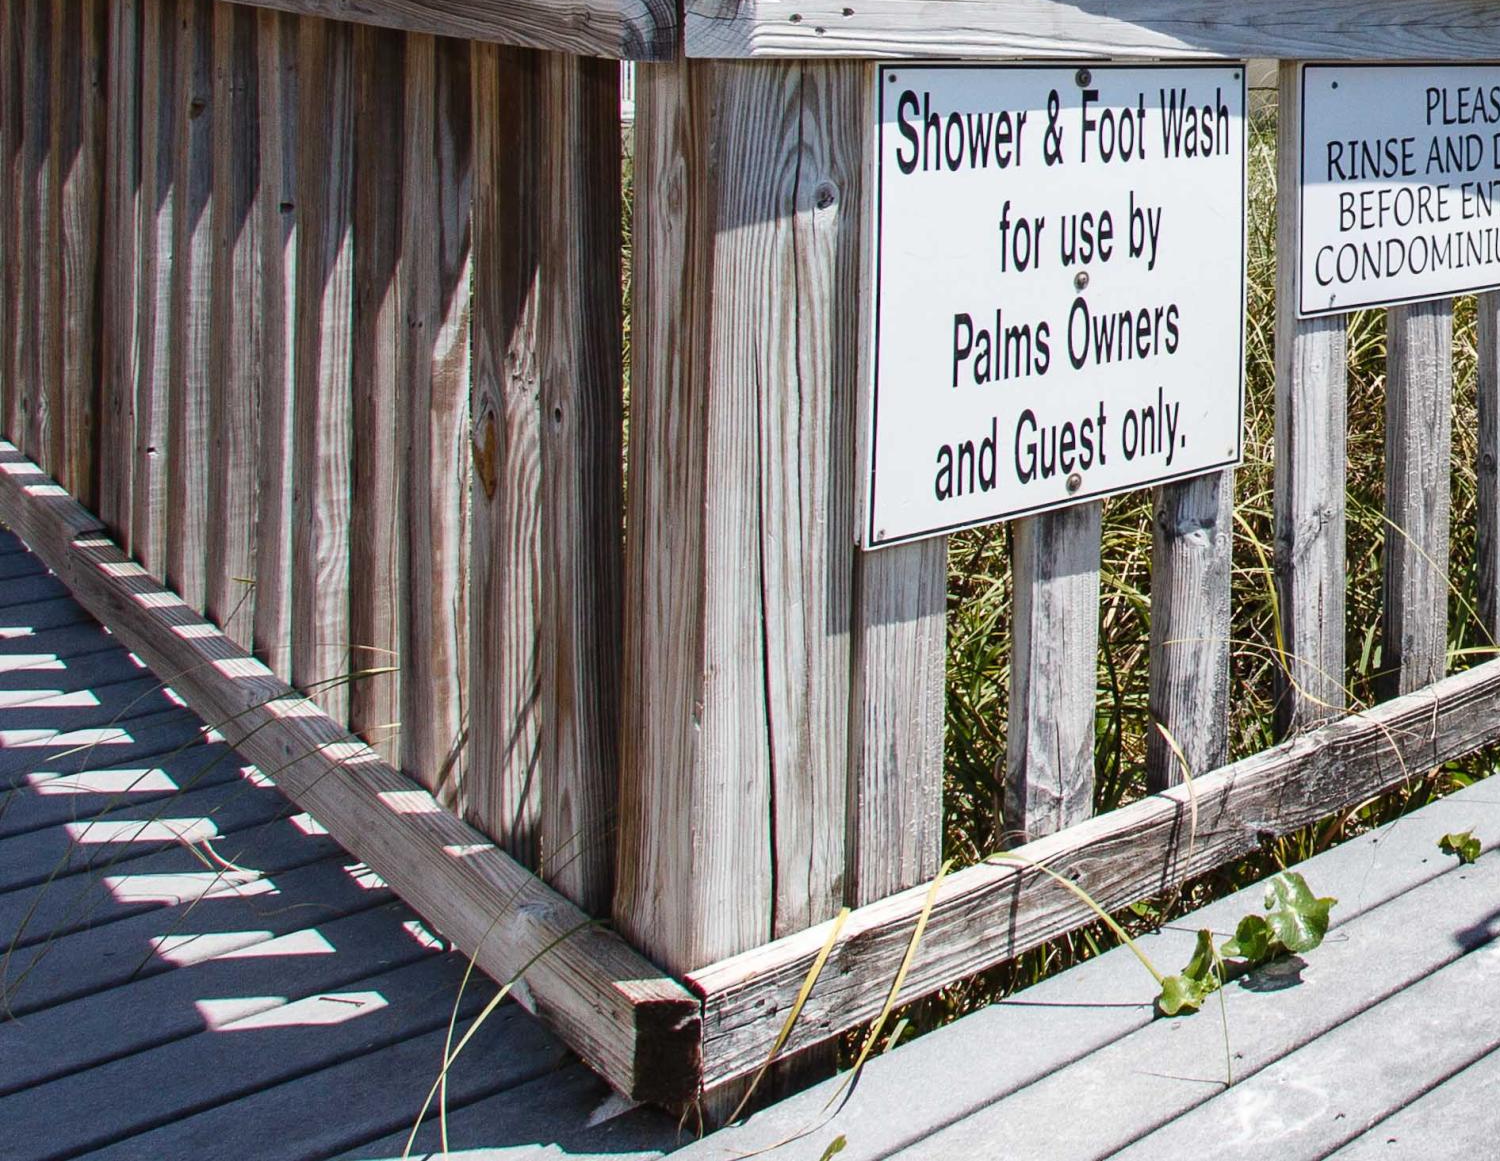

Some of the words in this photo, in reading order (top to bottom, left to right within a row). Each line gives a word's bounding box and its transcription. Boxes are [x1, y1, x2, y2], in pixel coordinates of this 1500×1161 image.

[896, 89, 1027, 175] Shower
[1044, 89, 1063, 166] &
[1081, 89, 1146, 163] Foot
[1160, 87, 1230, 159] Wash
[1327, 137, 1417, 181] RINSE
[1426, 133, 1483, 174] AND
[999, 200, 1044, 272] for
[1061, 209, 1113, 267] use
[1130, 191, 1162, 271] by
[1339, 184, 1450, 232] BEFORE
[953, 308, 1050, 388] Palms
[1068, 296, 1180, 370] Owners
[935, 417, 997, 501] and
[1015, 401, 1107, 484] Guest
[1122, 386, 1186, 466] only.
